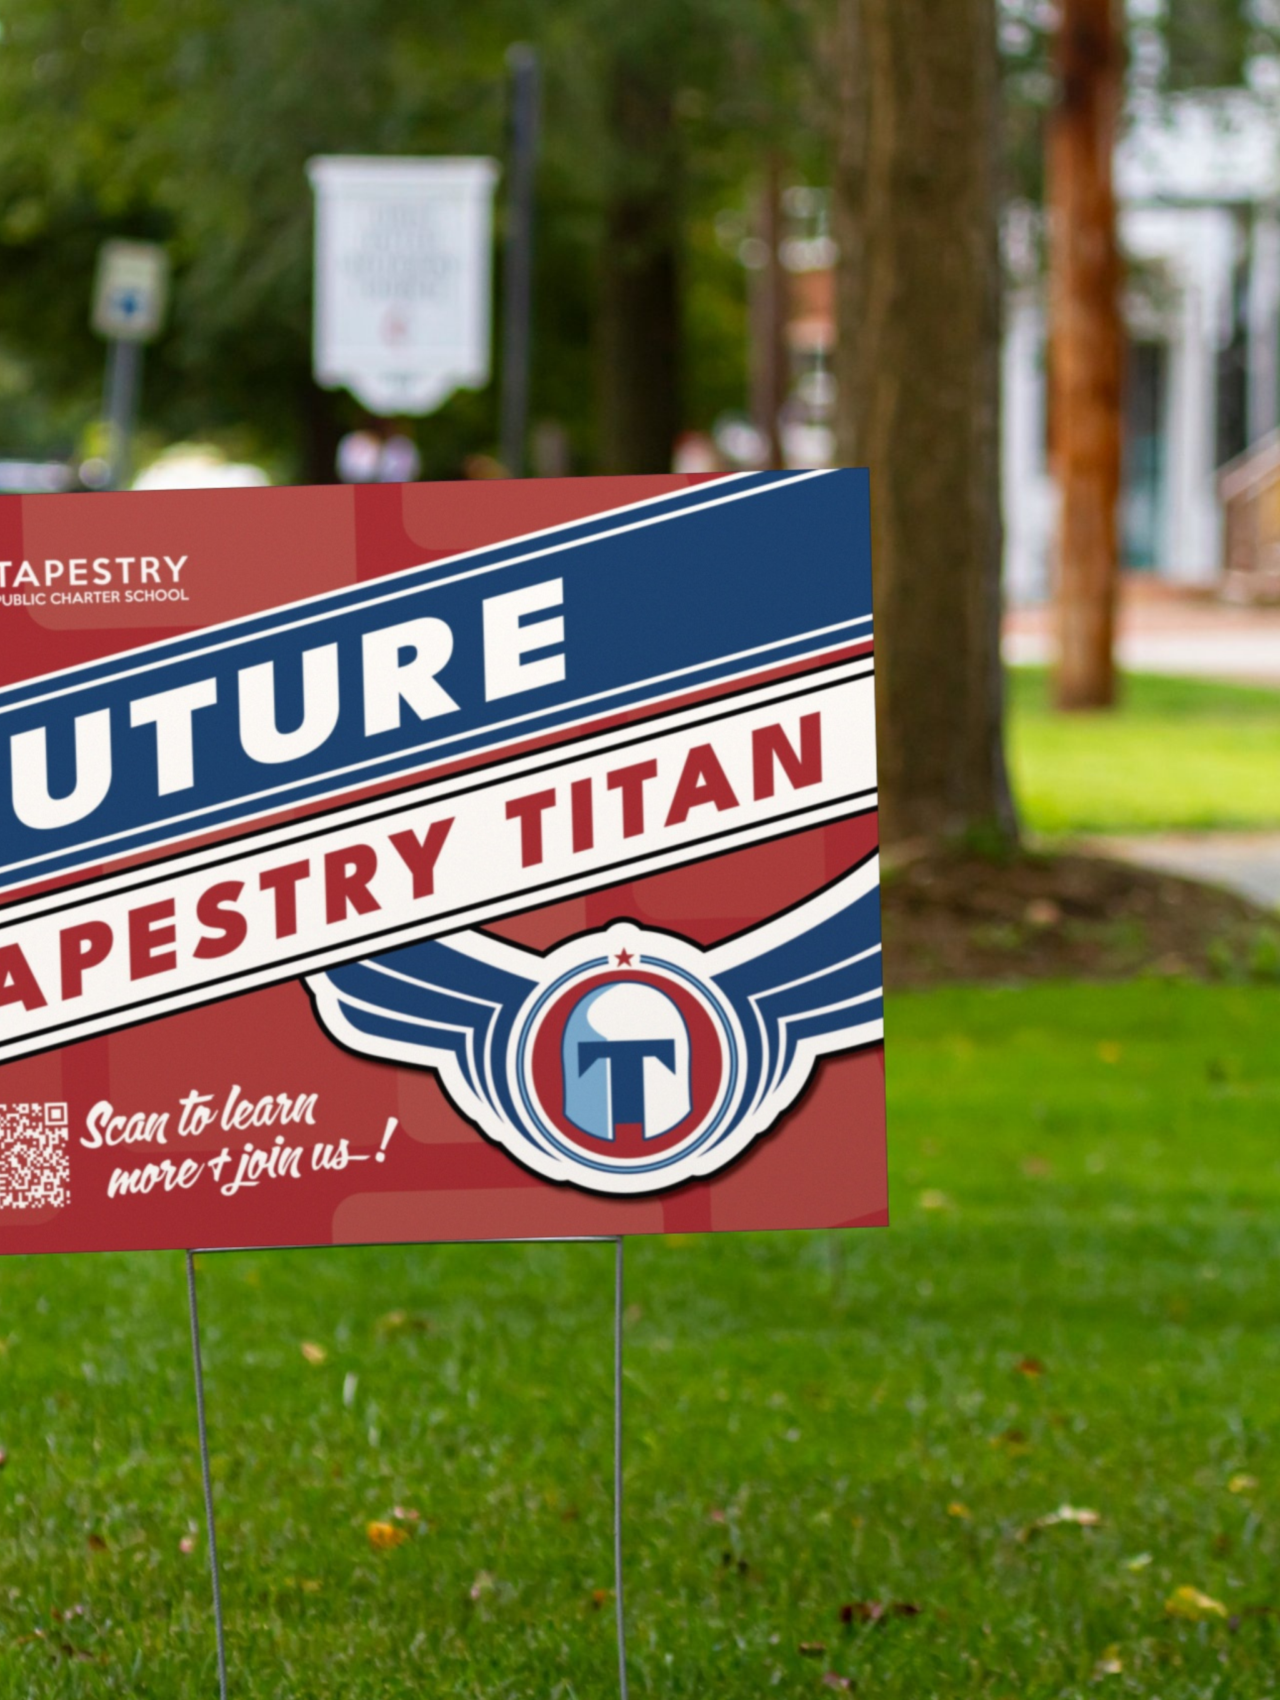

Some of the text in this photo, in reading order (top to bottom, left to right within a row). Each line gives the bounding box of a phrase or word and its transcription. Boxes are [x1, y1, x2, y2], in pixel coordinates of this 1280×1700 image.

[50, 590, 120, 605] CHARTER
[124, 588, 190, 603] SCHOOL
[505, 712, 822, 868] TITAN
[79, 1084, 319, 1149] Scan to learn
[107, 1158, 205, 1199] more
[220, 1135, 304, 1197] join
